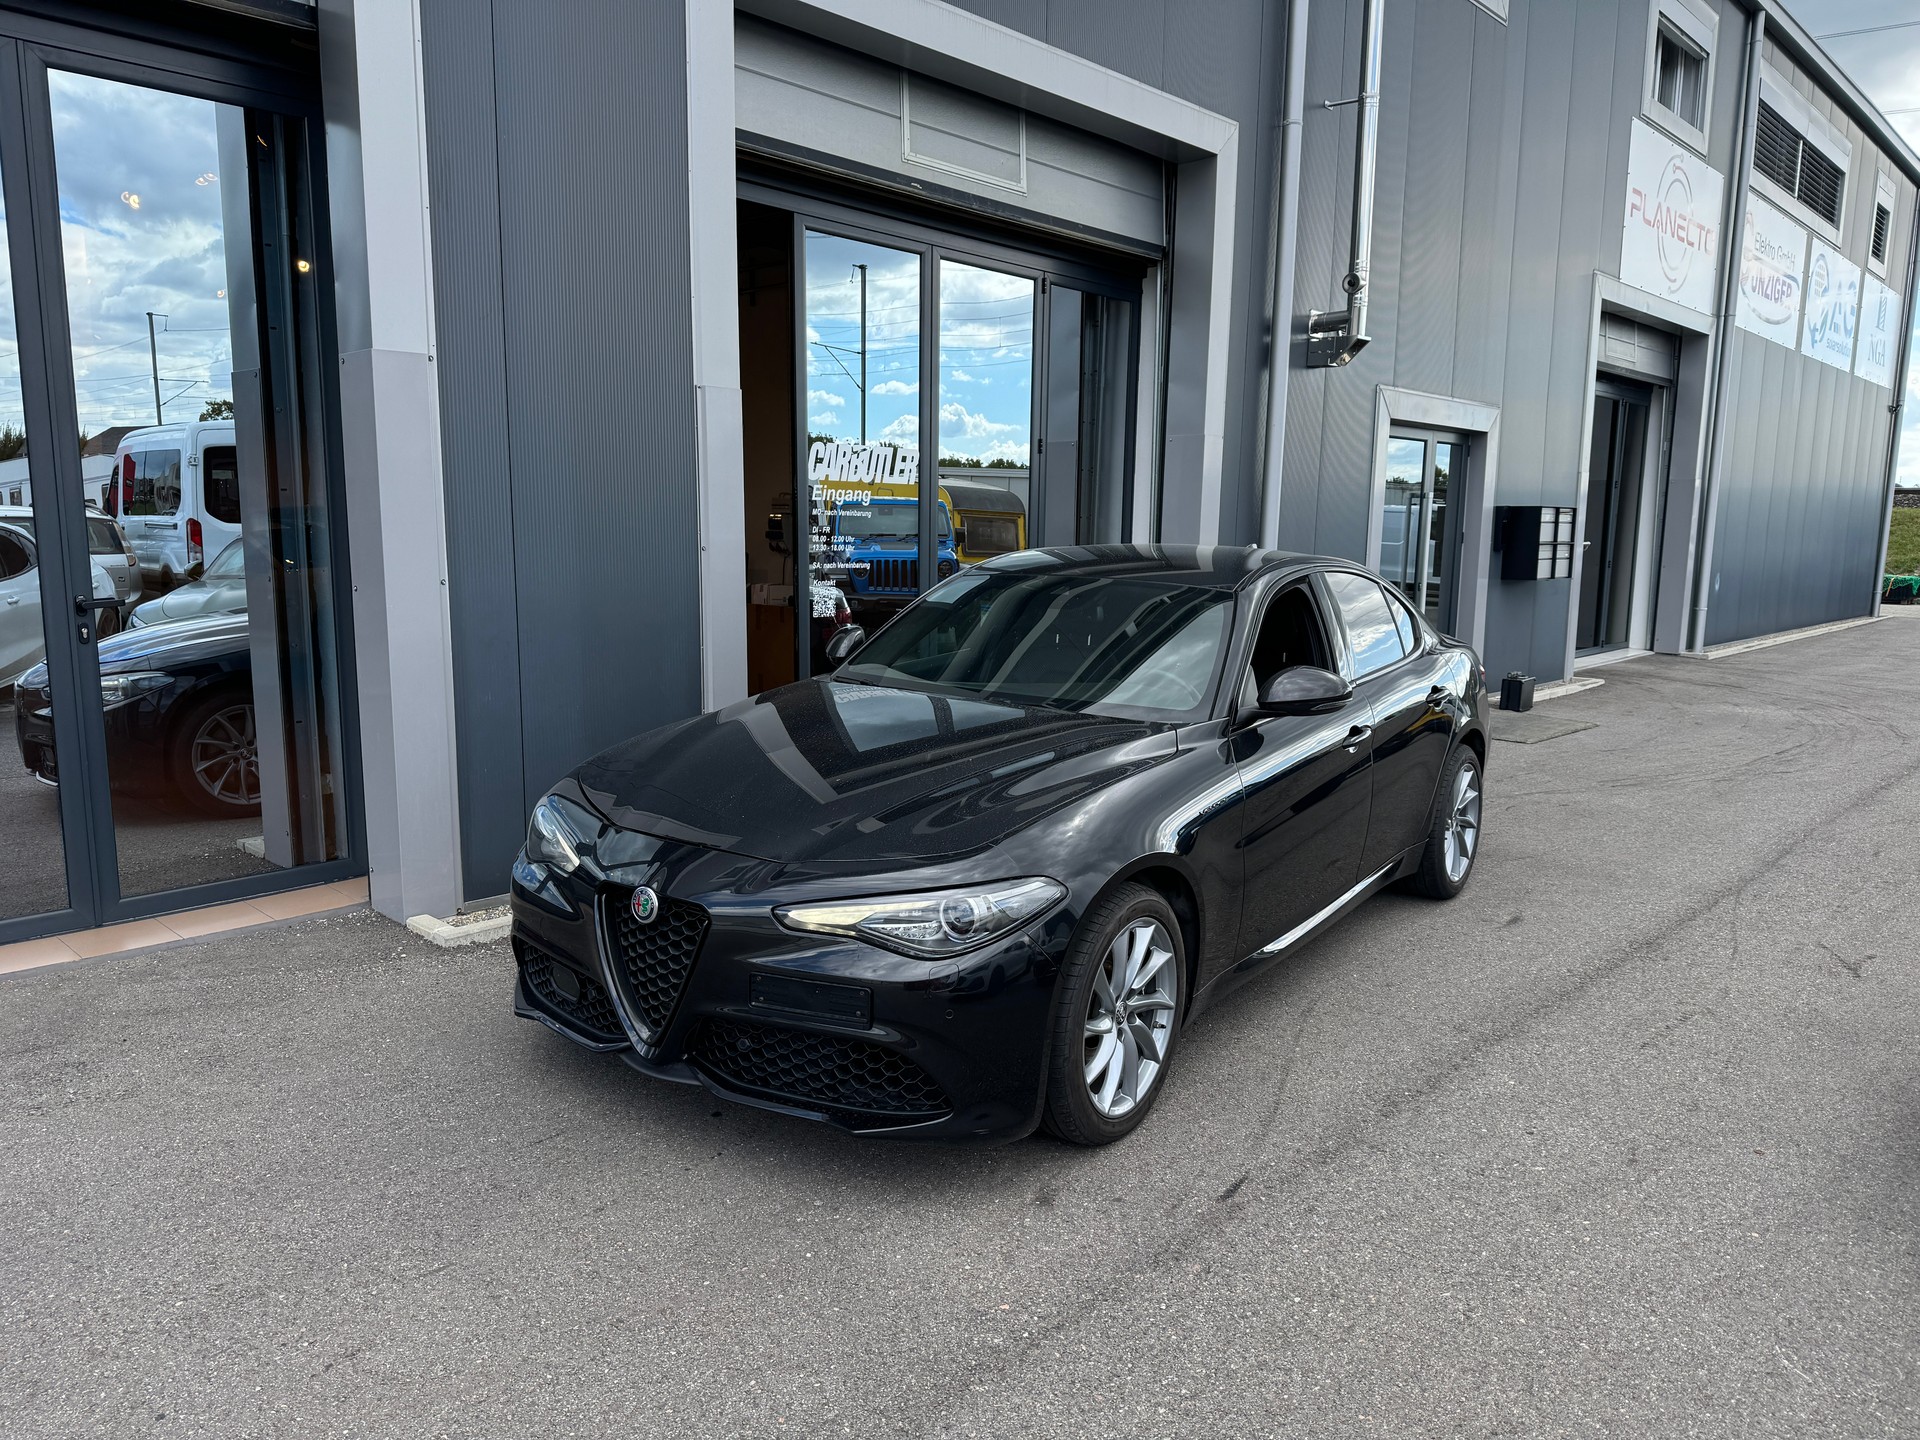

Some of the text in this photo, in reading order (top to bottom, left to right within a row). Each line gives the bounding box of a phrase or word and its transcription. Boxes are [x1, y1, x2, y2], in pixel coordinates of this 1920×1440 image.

[808, 441, 919, 485] CARBUTLER
[812, 484, 871, 506] Eingang
[838, 509, 872, 519] Vereinbarung
[837, 562, 871, 570] Vereinbarung
